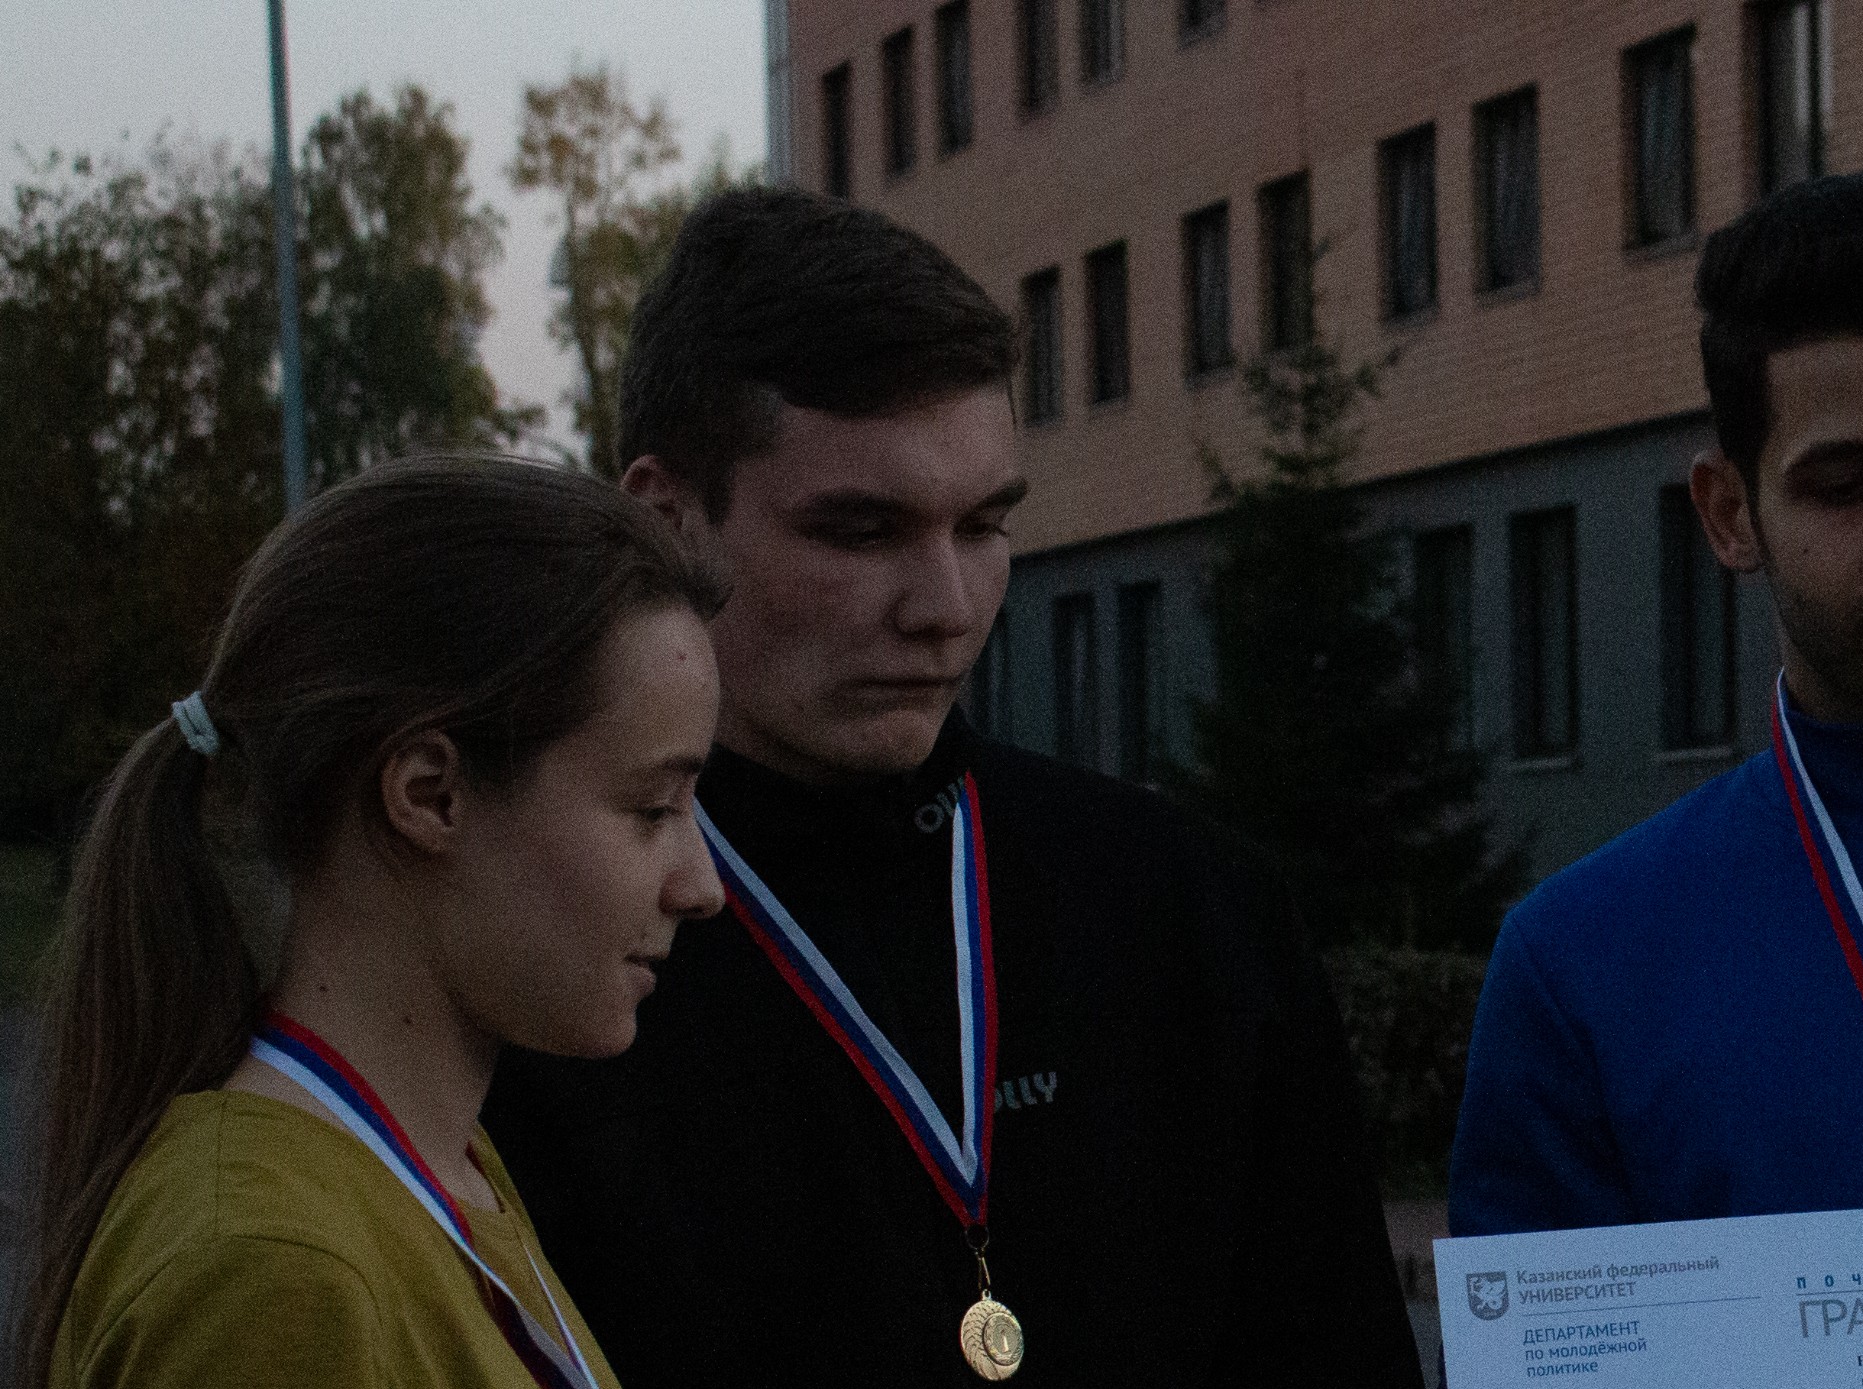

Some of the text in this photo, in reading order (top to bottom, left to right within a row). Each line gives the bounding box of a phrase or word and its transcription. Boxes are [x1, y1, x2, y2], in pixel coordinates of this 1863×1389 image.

[1516, 1257, 1719, 1285] Казанский федеральный
[1518, 1281, 1636, 1304] УНИВЕРСИТЕТ
[1523, 1320, 1640, 1345] ДЕПАРТАМЕНТ
[1525, 1337, 1647, 1361] по молодёжной
[1527, 1361, 1599, 1378] политике
